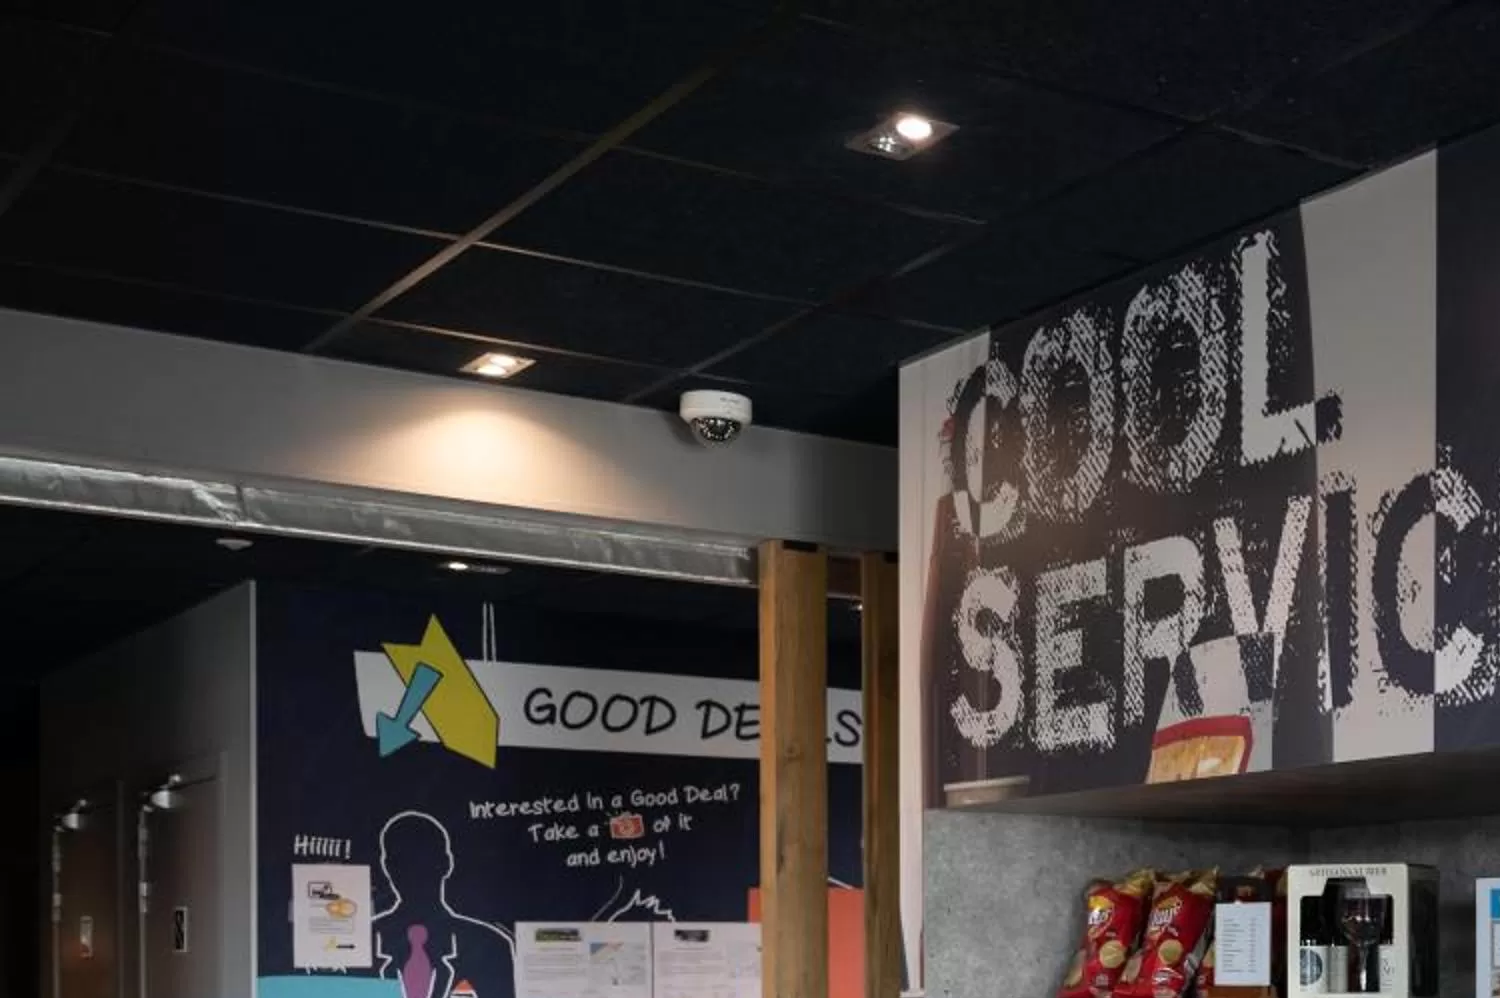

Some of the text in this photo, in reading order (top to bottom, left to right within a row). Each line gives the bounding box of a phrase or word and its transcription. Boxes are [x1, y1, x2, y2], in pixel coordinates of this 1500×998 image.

[946, 230, 1342, 544] COOL
[523, 687, 862, 747] GOOD DES
[469, 795, 579, 818] Interested
[611, 796, 623, 809] a
[630, 789, 678, 806] Good
[683, 783, 740, 802] Deal?
[527, 813, 693, 843] Take a of it
[567, 840, 665, 867] and enjoy!
